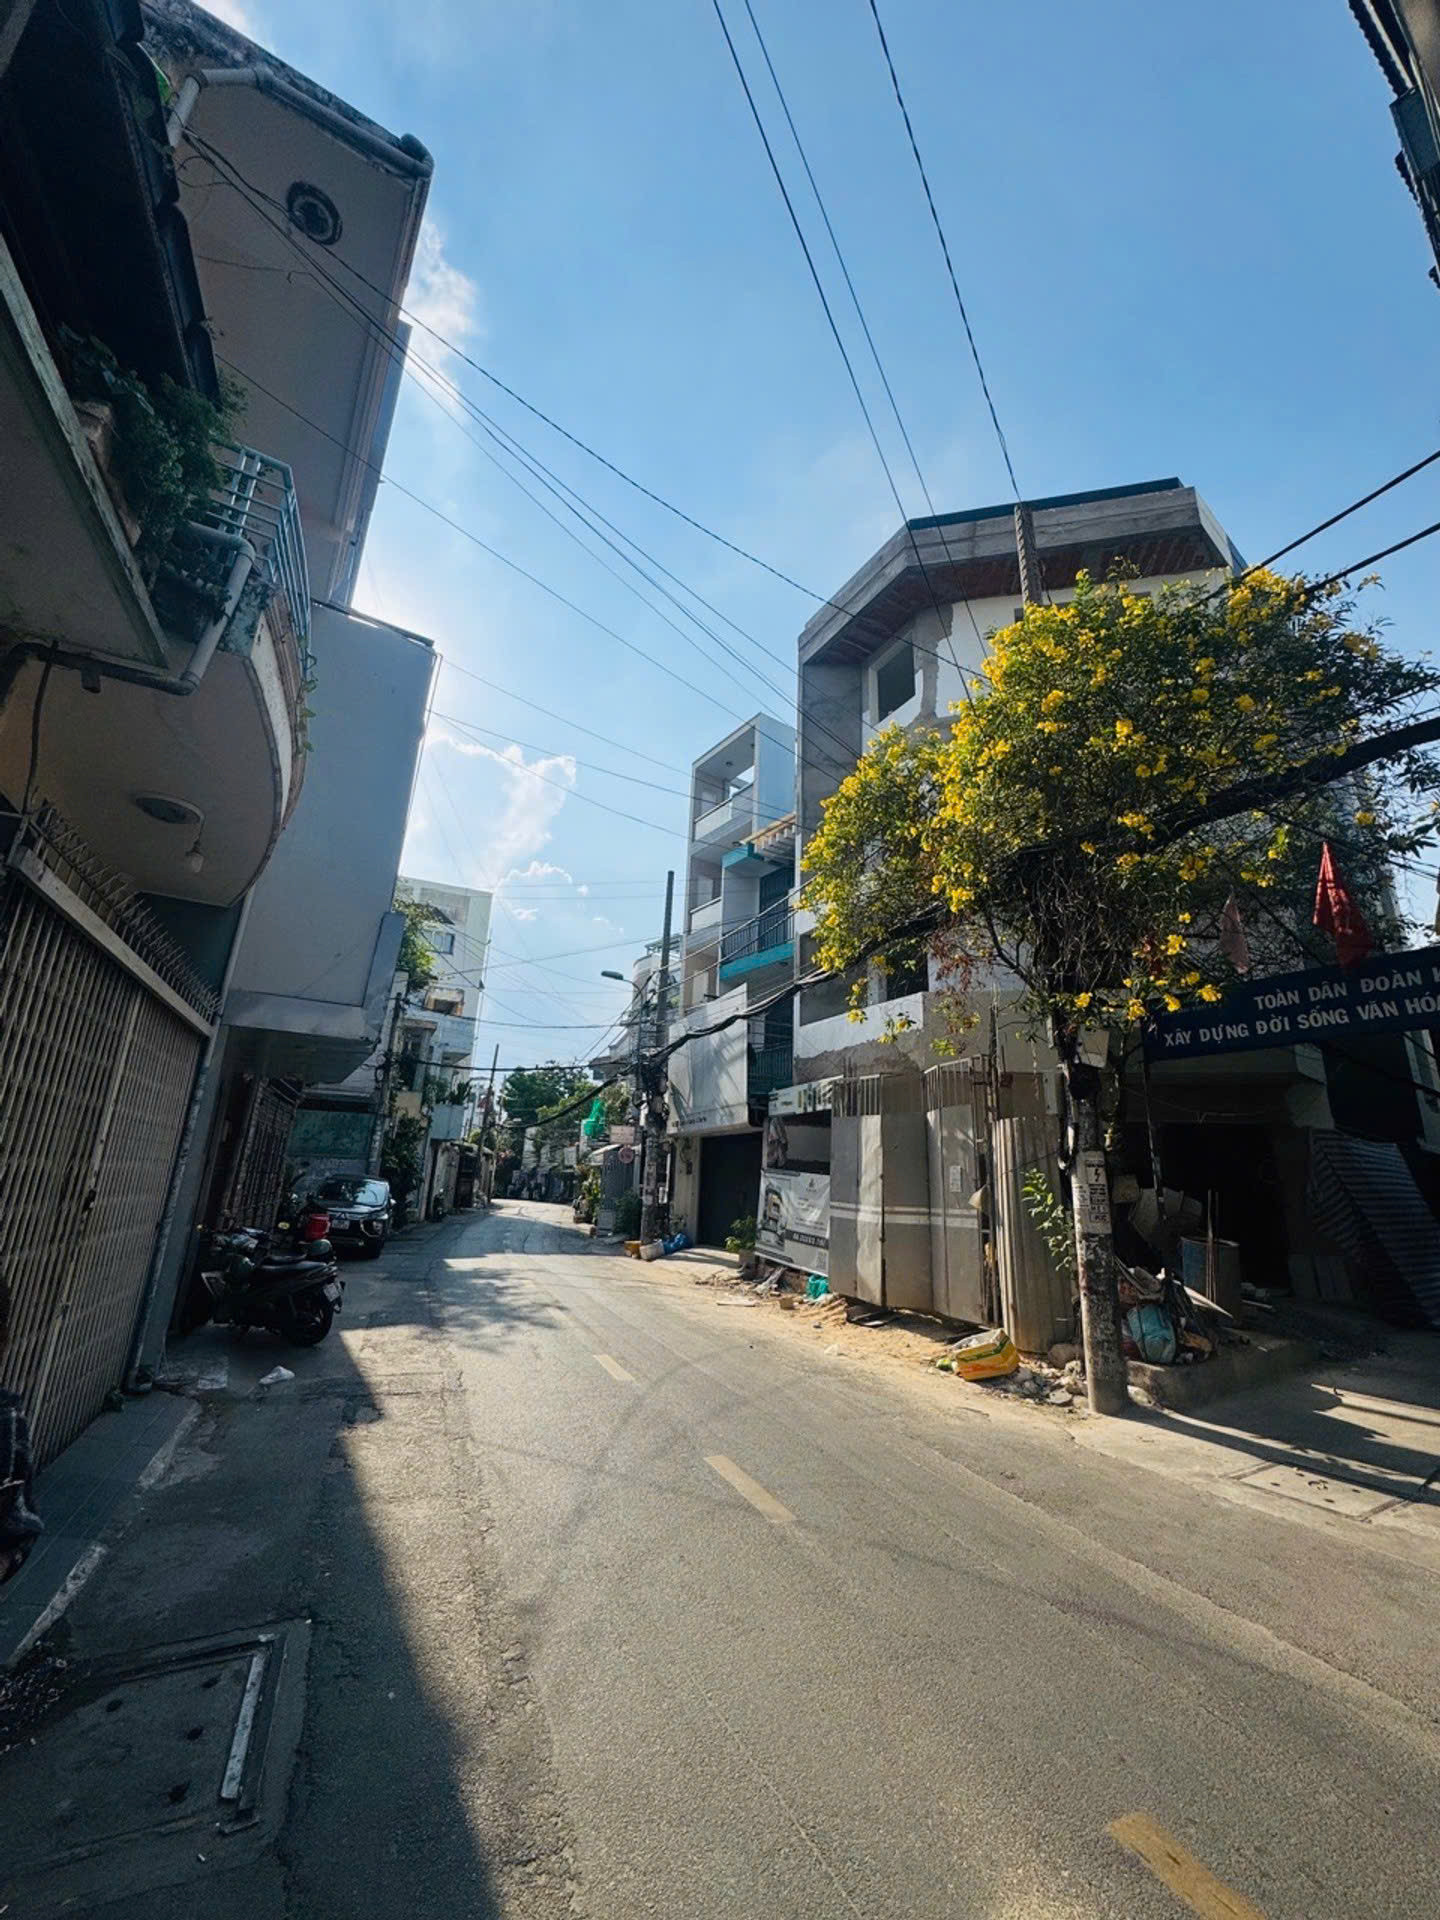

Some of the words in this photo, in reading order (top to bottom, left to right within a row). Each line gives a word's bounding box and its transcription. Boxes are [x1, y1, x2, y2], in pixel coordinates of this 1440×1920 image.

[1254, 988, 1300, 1011] TOÀN
[1307, 979, 1348, 1002] DÂN
[1360, 968, 1423, 994] ĐOÀN
[1164, 1027, 1192, 1047] XÂY
[1199, 1023, 1250, 1044] DỰNG
[1255, 1013, 1291, 1036] ĐỜI
[1298, 1004, 1350, 1030] SỐNG
[1356, 999, 1400, 1022] VĂN
[1405, 992, 1440, 1016] HÓ
